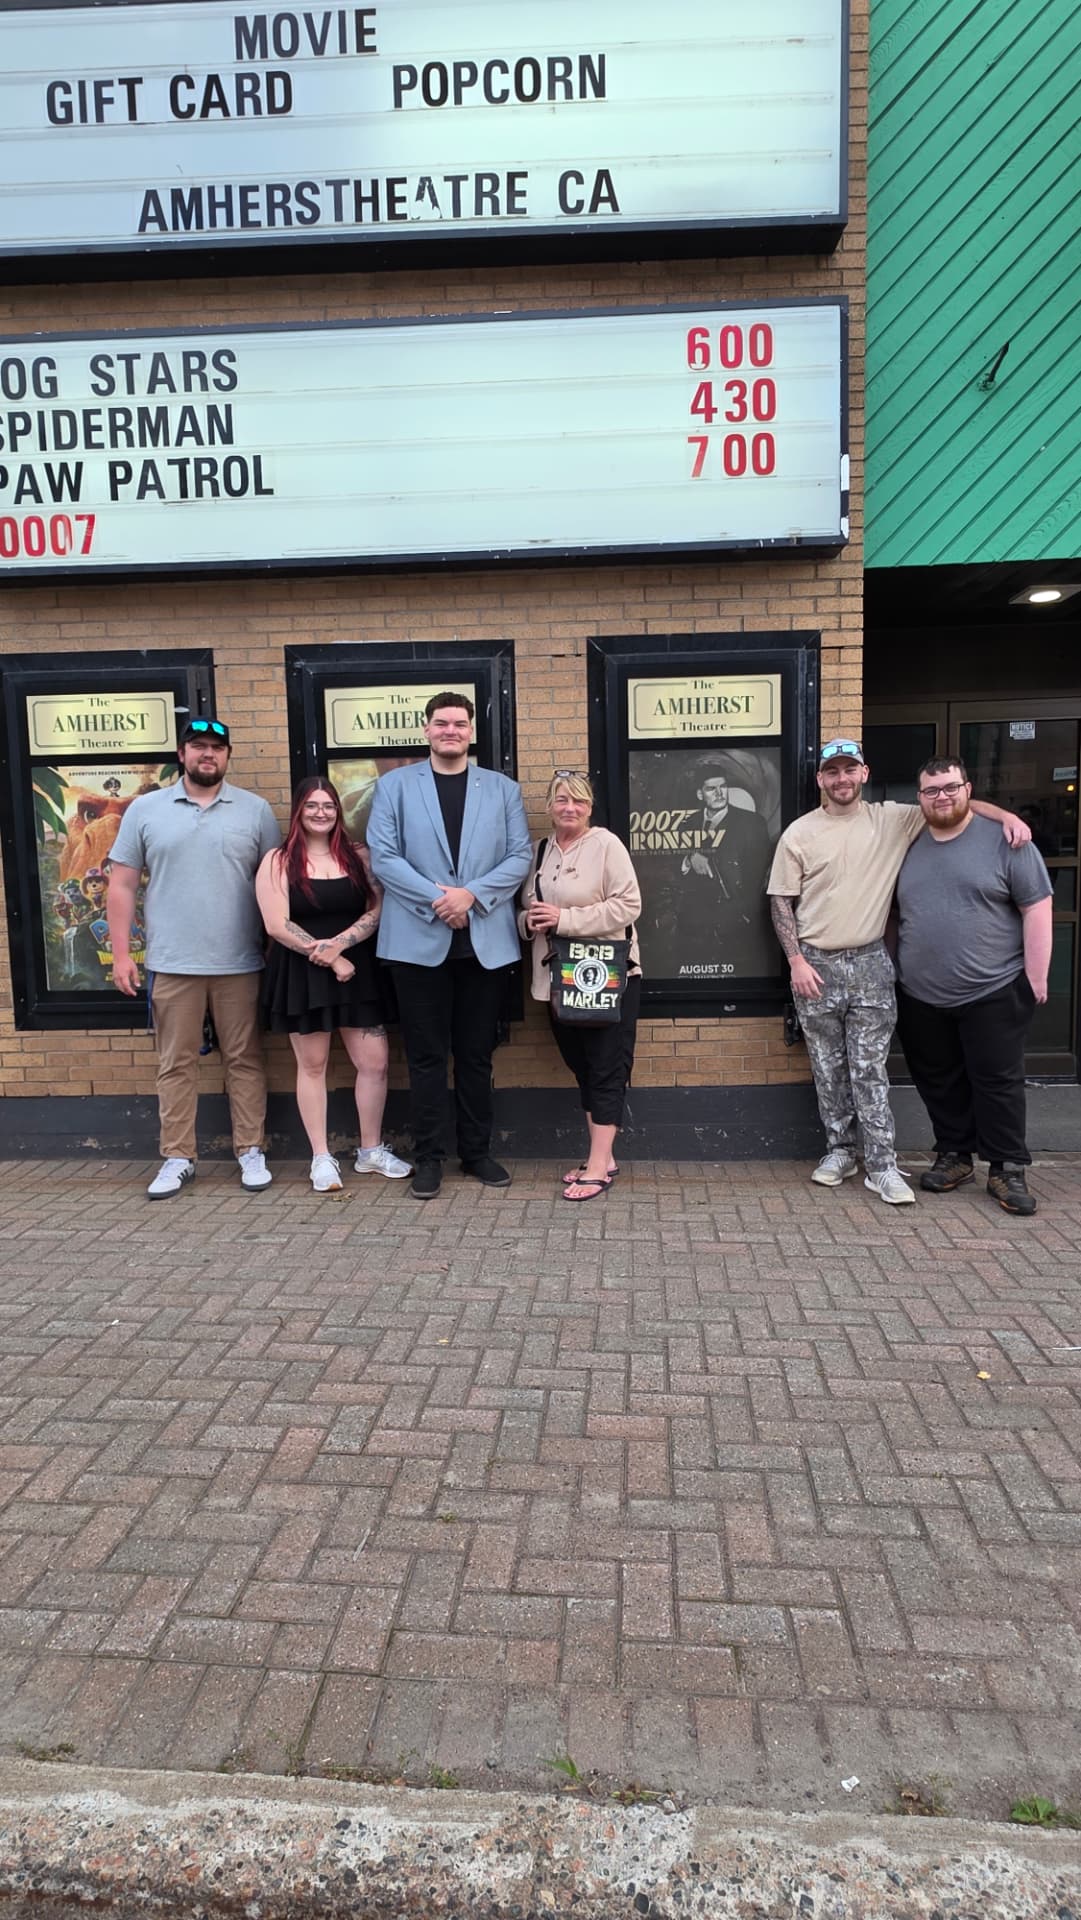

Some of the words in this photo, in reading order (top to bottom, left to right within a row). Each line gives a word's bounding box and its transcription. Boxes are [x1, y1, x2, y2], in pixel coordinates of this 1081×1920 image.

[234, 9, 378, 60] MOVIE
[46, 77, 143, 124] GIFT
[169, 70, 293, 119] CARD
[393, 53, 606, 108] POPCORN
[138, 171, 528, 232] AMHERSTHEATRE
[558, 169, 620, 214] CA
[687, 323, 773, 370] 600
[90, 349, 238, 397] STARS
[690, 378, 776, 424] 430
[0, 403, 235, 453] PIDERMAN
[687, 432, 775, 478] 700
[108, 455, 274, 501] PATROL
[0, 514, 96, 558] 0007
[687, 680, 715, 689] The
[87, 697, 110, 707] The
[387, 695, 412, 704] The
[653, 695, 755, 716] AMHERST
[52, 712, 150, 733] AMHERST
[352, 710, 427, 731] AMHER
[680, 722, 727, 732] Theatre
[78, 738, 125, 749] Theatre
[378, 736, 425, 746] Theatre
[630, 829, 726, 851] RONSPY
[569, 943, 615, 961] BOB
[680, 964, 719, 974] AUGUST
[721, 964, 734, 973] 30
[563, 990, 618, 1009] MARLEY
